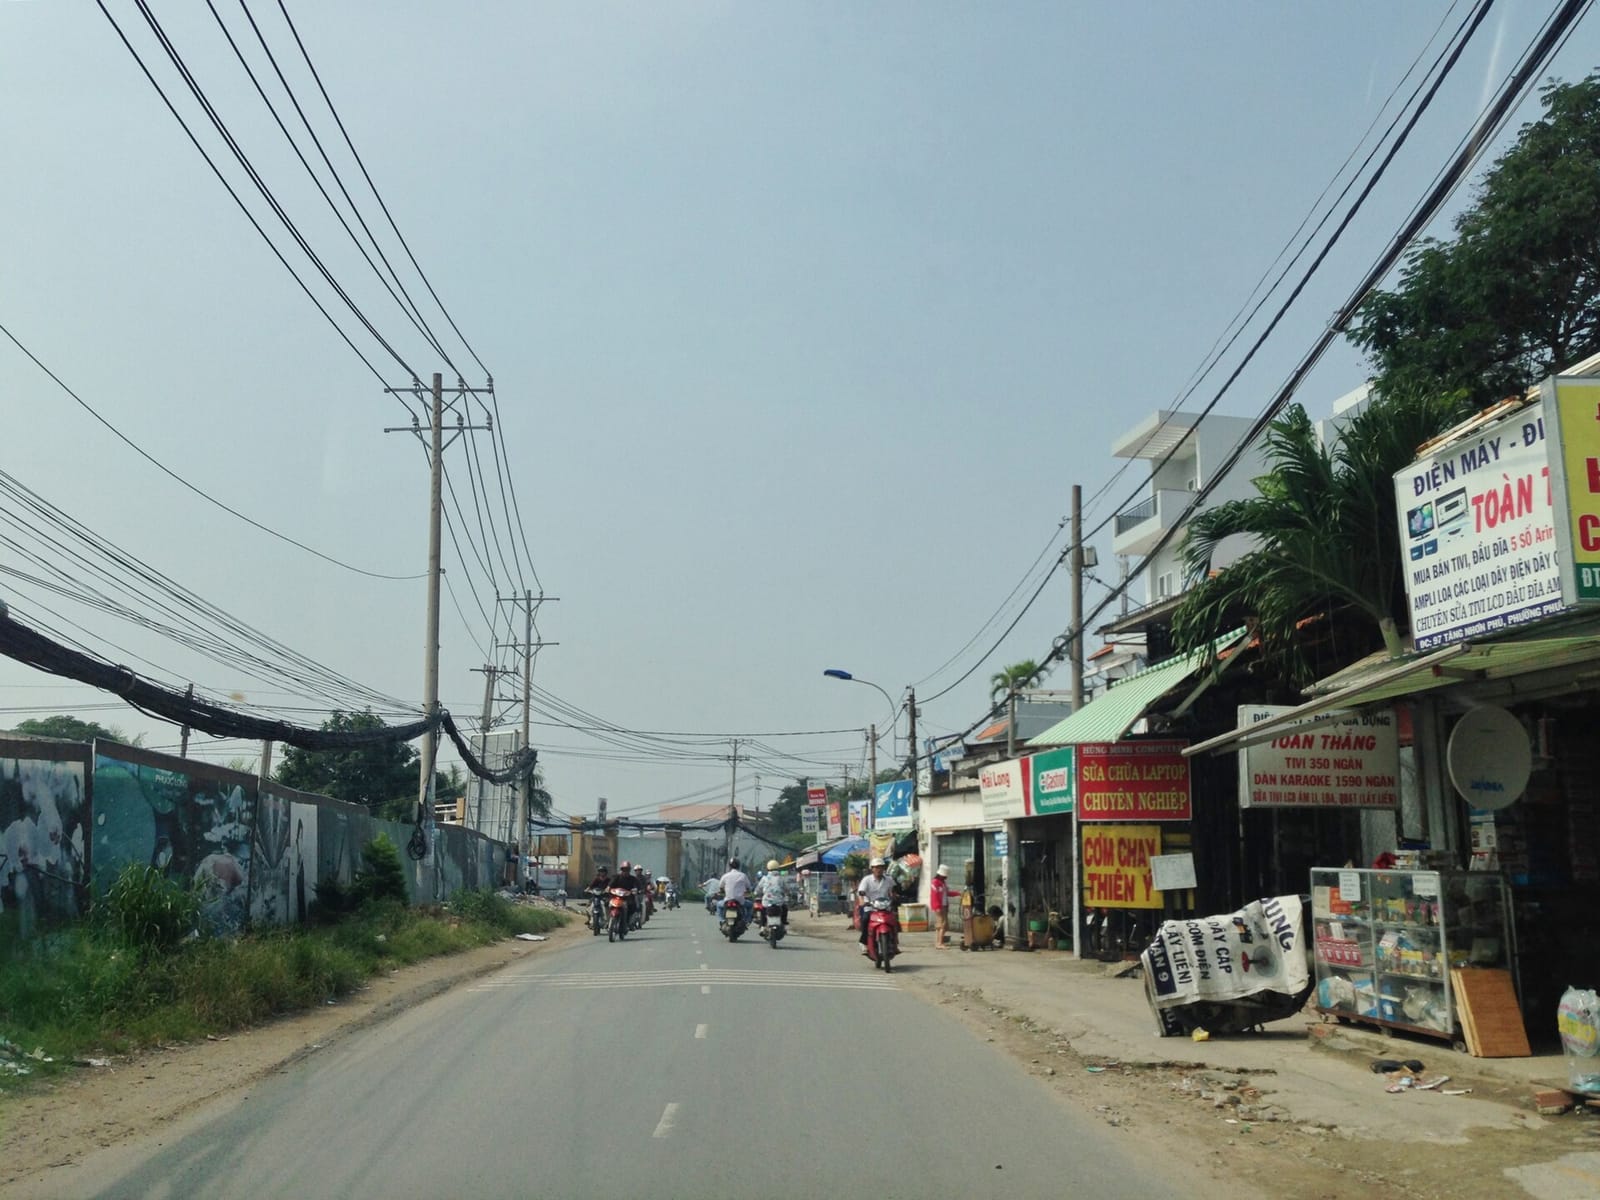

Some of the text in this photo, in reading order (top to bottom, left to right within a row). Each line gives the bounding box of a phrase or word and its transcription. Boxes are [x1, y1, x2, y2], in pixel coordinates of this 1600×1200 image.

[1413, 459, 1456, 497] ĐIỆN
[1460, 436, 1501, 475] MÁY
[1471, 473, 1533, 533] TOÀN
[1413, 568, 1431, 586] MUA
[1432, 557, 1450, 580] BÁN
[1472, 539, 1491, 565] ĐẦU
[1492, 536, 1509, 558] ĐĨA
[1510, 535, 1518, 552] 5
[1519, 524, 1533, 549] SỐ
[1414, 591, 1436, 611] AMPLI
[1437, 585, 1452, 603] LOA
[1453, 577, 1469, 599] CÁC
[1471, 572, 1490, 594] LOẠI
[1491, 564, 1508, 587] DÂY
[1510, 557, 1531, 582] ĐIỆN
[1533, 551, 1551, 573] DÂY
[1468, 598, 1486, 618] TIVI
[1487, 592, 1505, 612] LCD
[1506, 580, 1526, 606] ĐẦU
[1527, 579, 1545, 600] ĐĨA
[1433, 634, 1442, 645] 97
[1321, 728, 1377, 751] THẮNG
[1082, 760, 1105, 781] SỬA
[1143, 764, 1186, 781] LAPTOP
[1284, 756, 1363, 770] TIVI 350 NGÀN
[993, 770, 1010, 788] Long
[1280, 774, 1331, 787] KARAOKE
[1336, 775, 1363, 787] 1590
[1365, 774, 1395, 788] NGÀN
[1083, 787, 1134, 811] CHUYÊN
[1138, 786, 1188, 814] NGHIỆP
[1084, 831, 1155, 868] CƠM CHAY
[1087, 868, 1135, 902] THIÊN
[1158, 971, 1170, 982] 9
